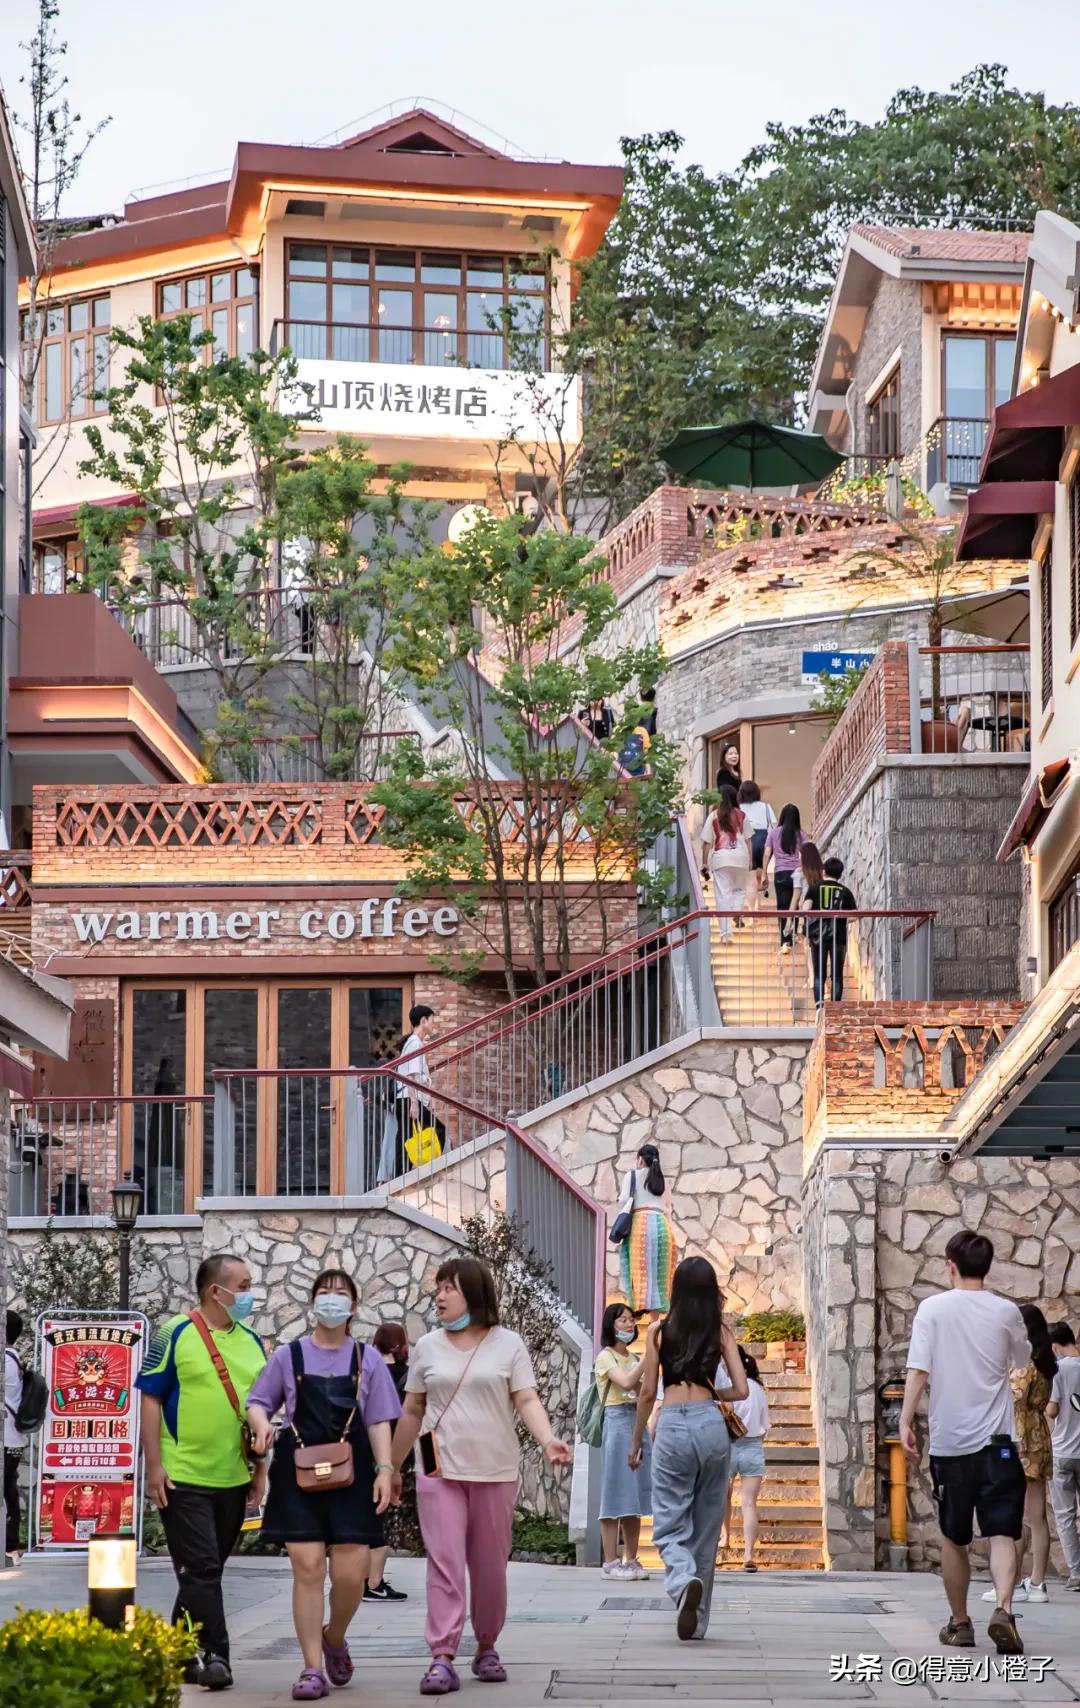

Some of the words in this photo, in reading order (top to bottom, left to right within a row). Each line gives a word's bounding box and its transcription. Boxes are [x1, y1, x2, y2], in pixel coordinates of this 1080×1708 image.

[307, 379, 487, 416] 山顶烧烤店
[71, 908, 280, 942] warmer
[300, 897, 460, 939] coffee
[53, 1420, 128, 1437] 国潮风格
